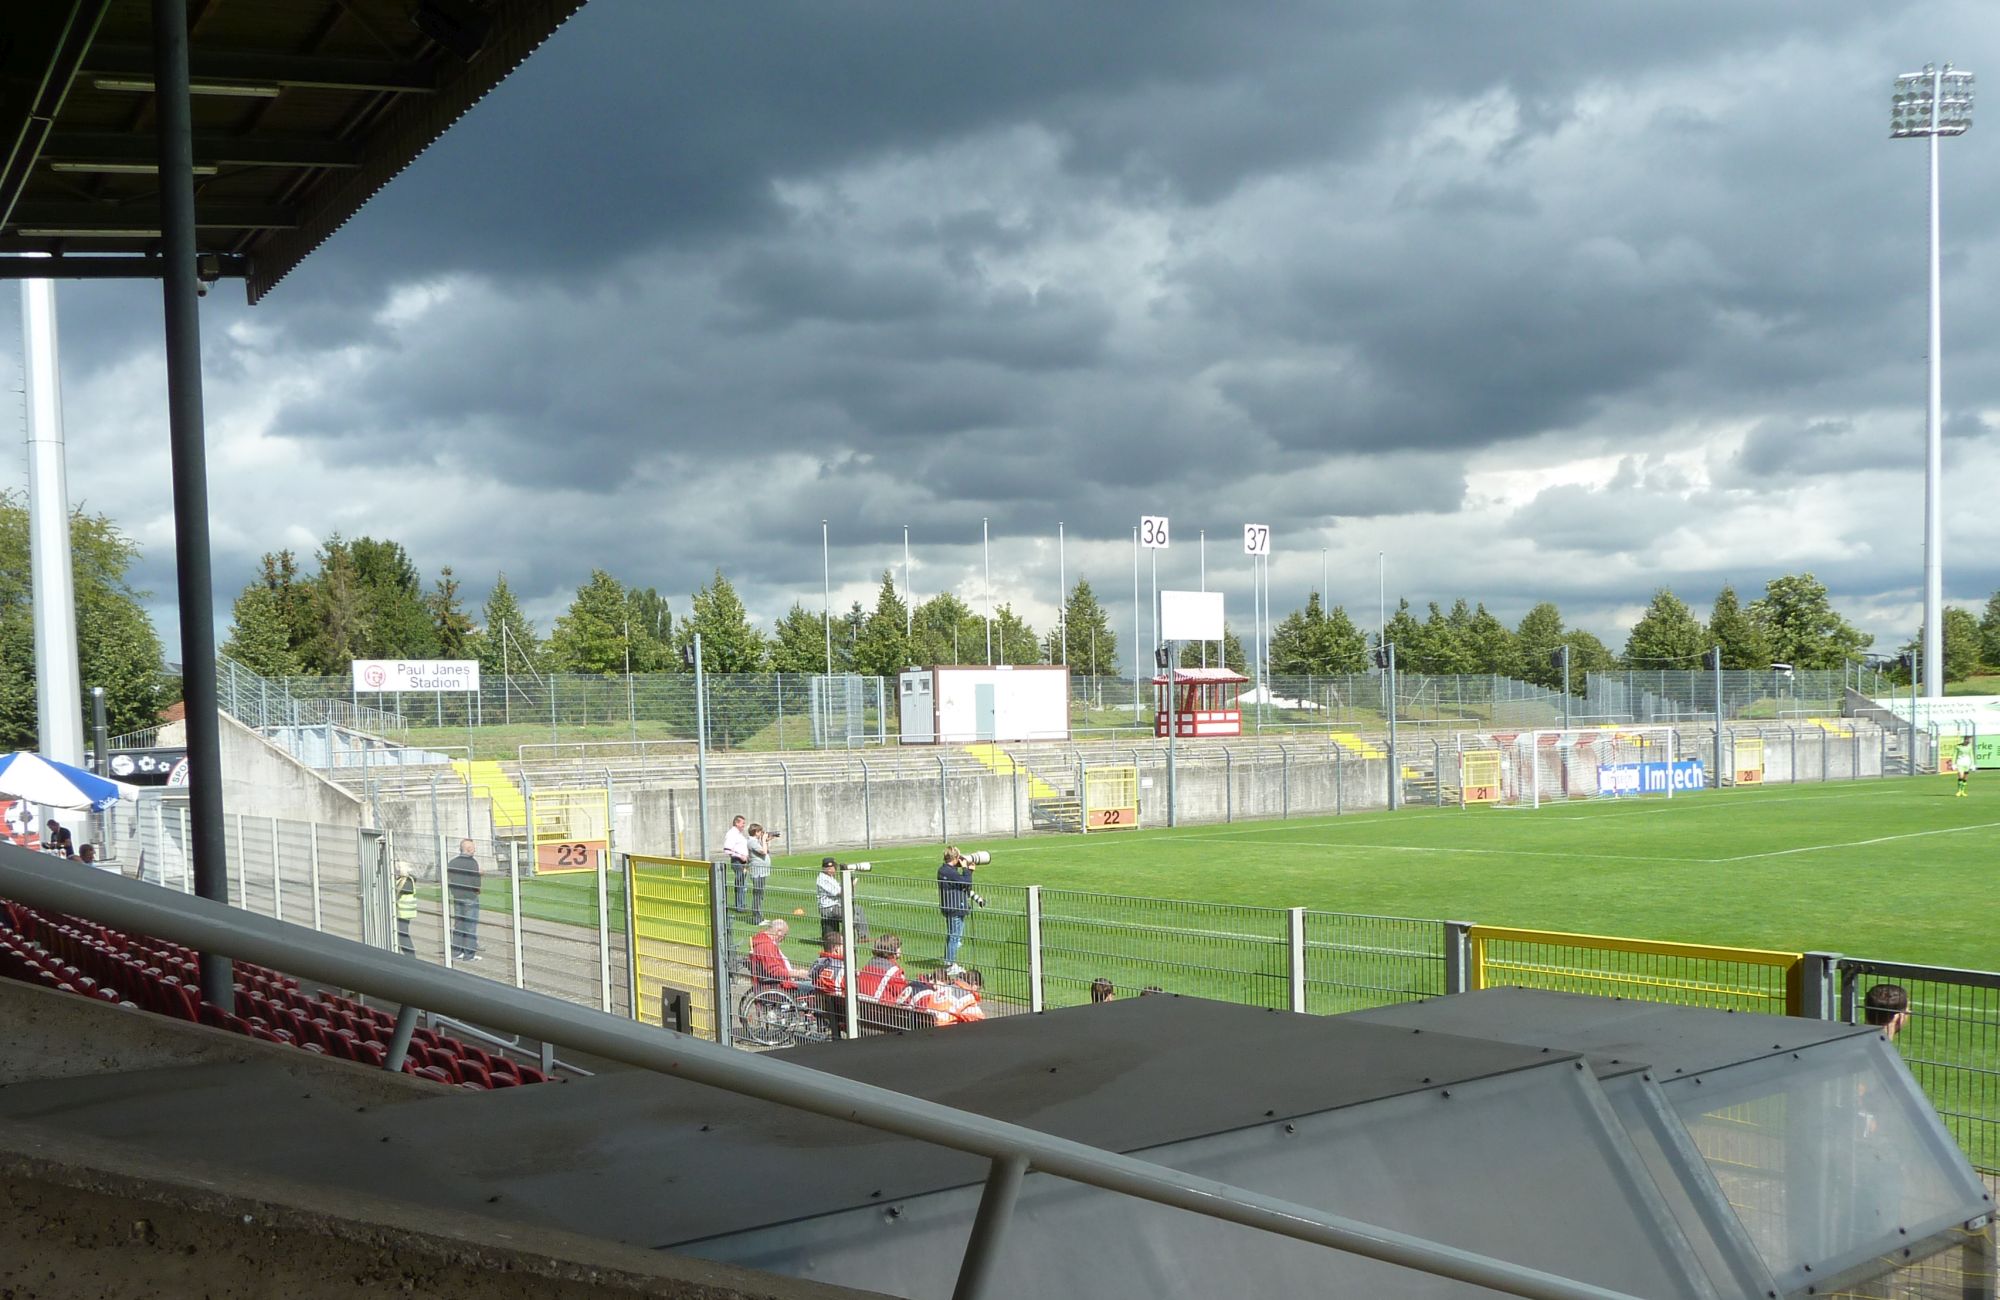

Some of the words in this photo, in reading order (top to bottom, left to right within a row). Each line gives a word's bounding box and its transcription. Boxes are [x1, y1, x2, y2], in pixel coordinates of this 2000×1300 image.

[1143, 519, 1166, 545] 36
[1246, 527, 1267, 551] 37
[397, 663, 425, 675] Paul
[432, 663, 470, 675] Janes
[410, 676, 460, 688] Stadion
[1644, 763, 1704, 790] Imtech
[1744, 770, 1753, 781] 20
[1477, 786, 1487, 800] 21
[1103, 810, 1120, 825] 22
[557, 843, 588, 866] 23
